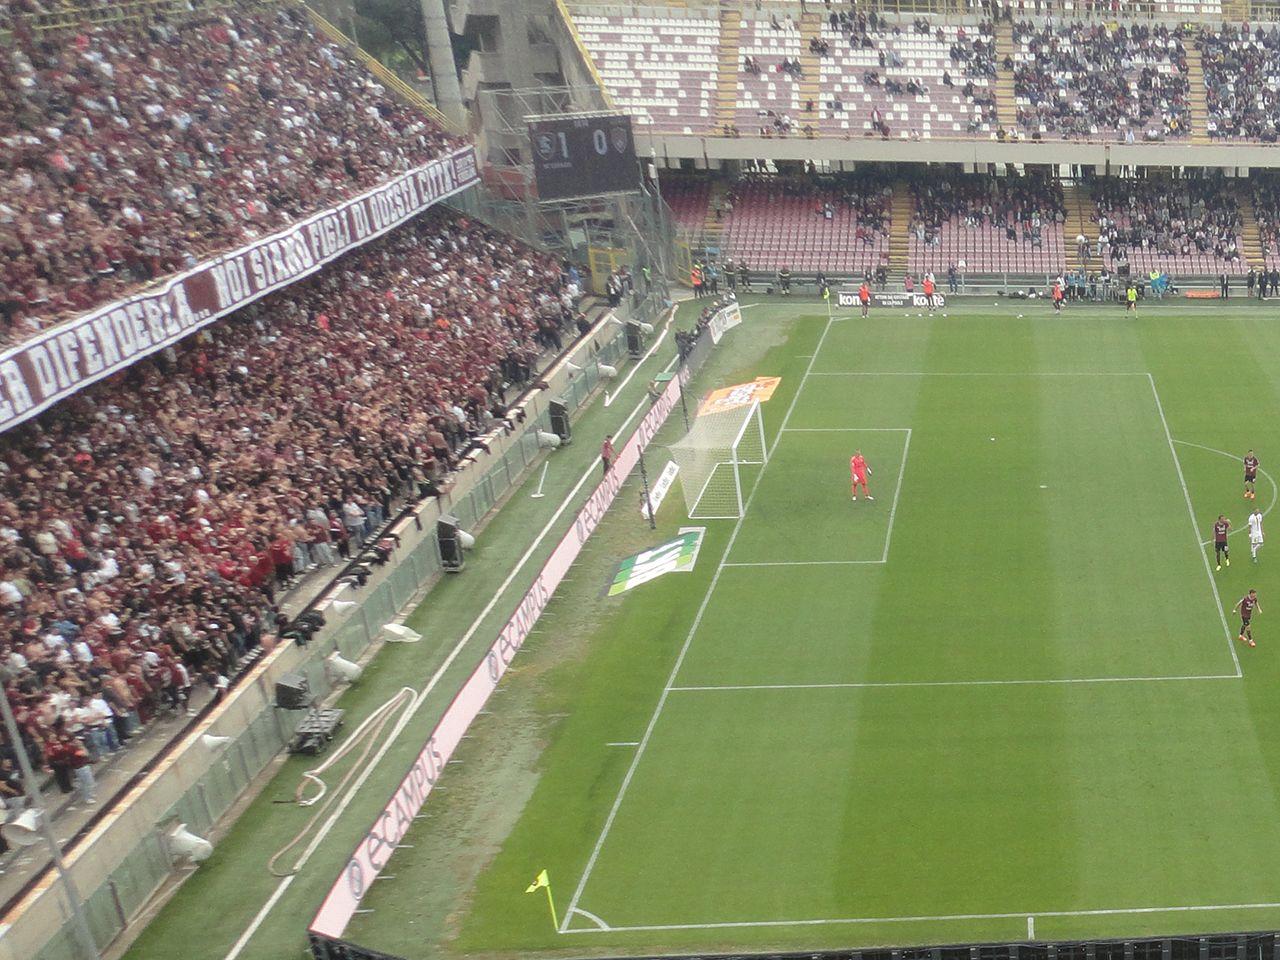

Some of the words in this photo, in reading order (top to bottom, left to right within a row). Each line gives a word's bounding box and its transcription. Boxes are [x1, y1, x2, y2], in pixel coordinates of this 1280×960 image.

[558, 131, 569, 158] 1
[593, 129, 608, 155] 0
[211, 256, 251, 308] NOI
[250, 232, 314, 289] SIAMO
[351, 202, 372, 240] DI
